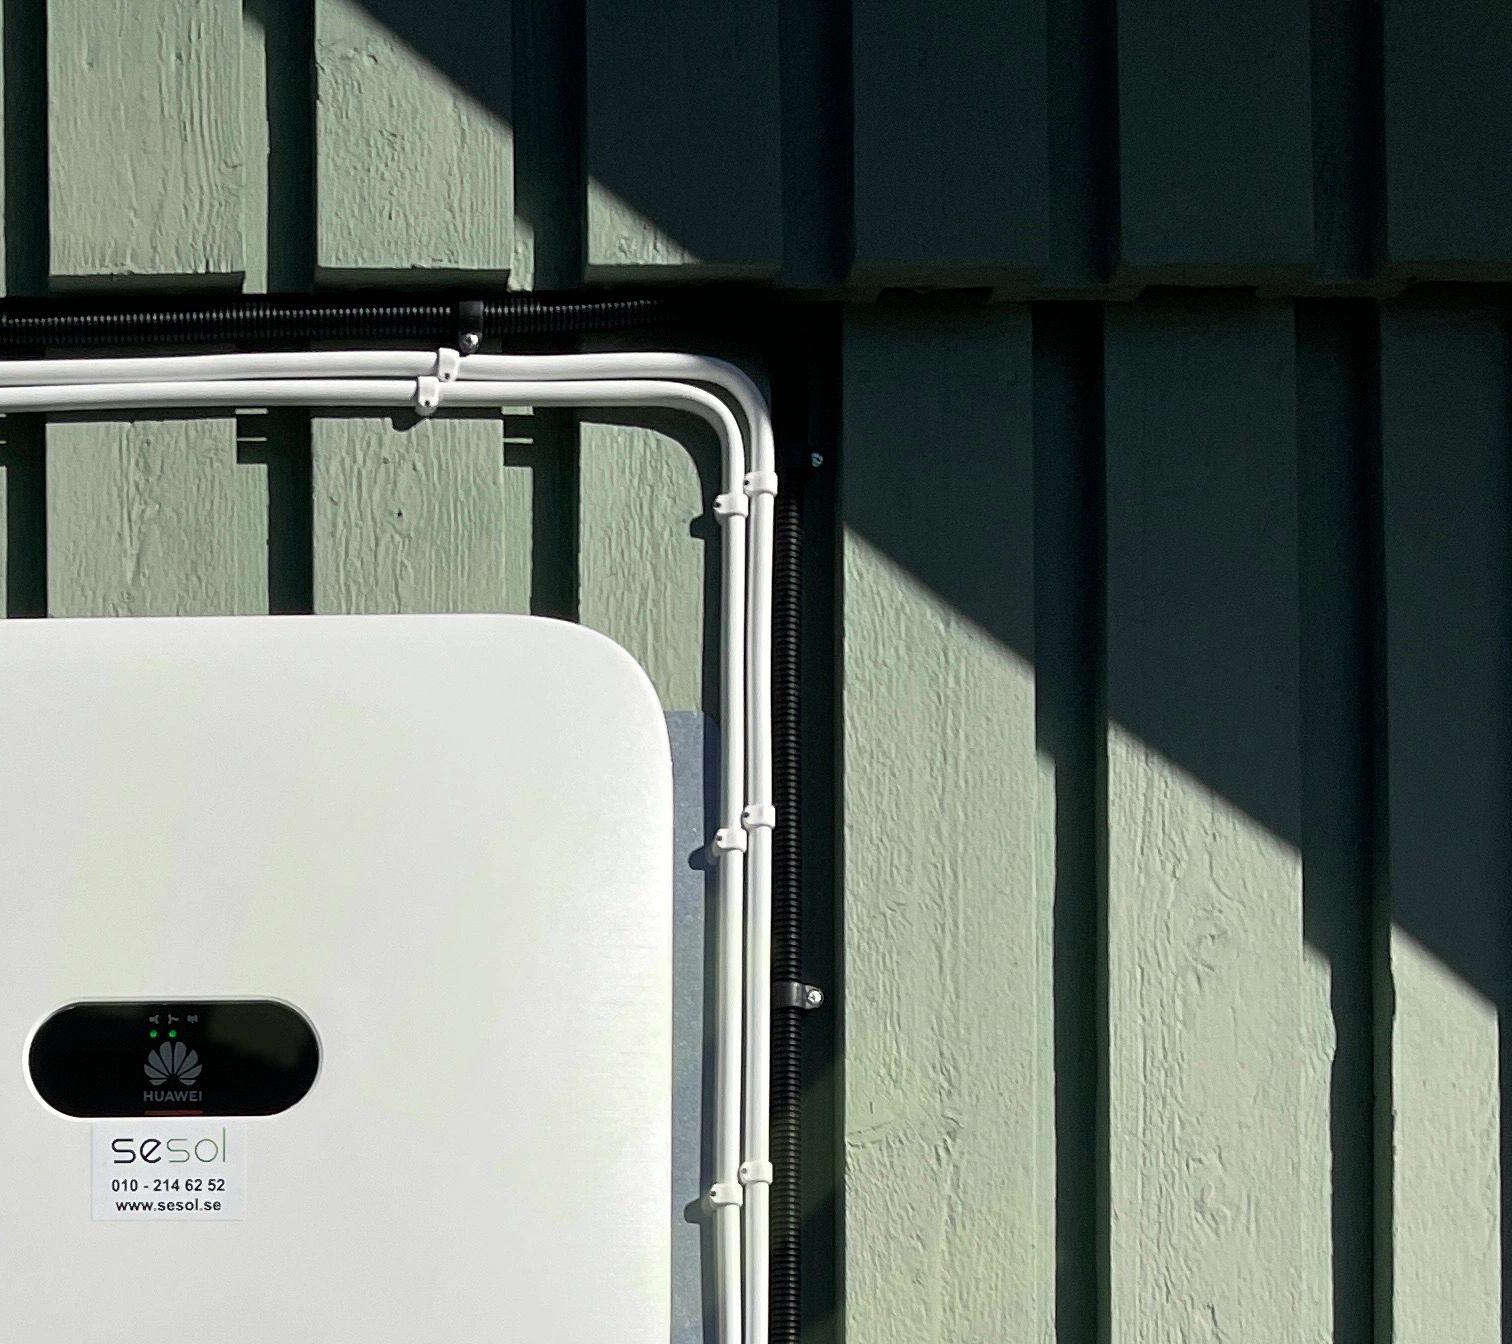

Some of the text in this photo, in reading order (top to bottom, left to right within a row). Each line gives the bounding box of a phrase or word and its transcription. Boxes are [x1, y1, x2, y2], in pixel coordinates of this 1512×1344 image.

[143, 1091, 202, 1102] HUAWEI
[111, 1128, 226, 1164] sesol
[111, 1179, 138, 1192] 010
[153, 1179, 179, 1192] 214
[185, 1179, 204, 1192] 62
[208, 1179, 226, 1192] 52
[116, 1198, 222, 1211] www.sesol.se
